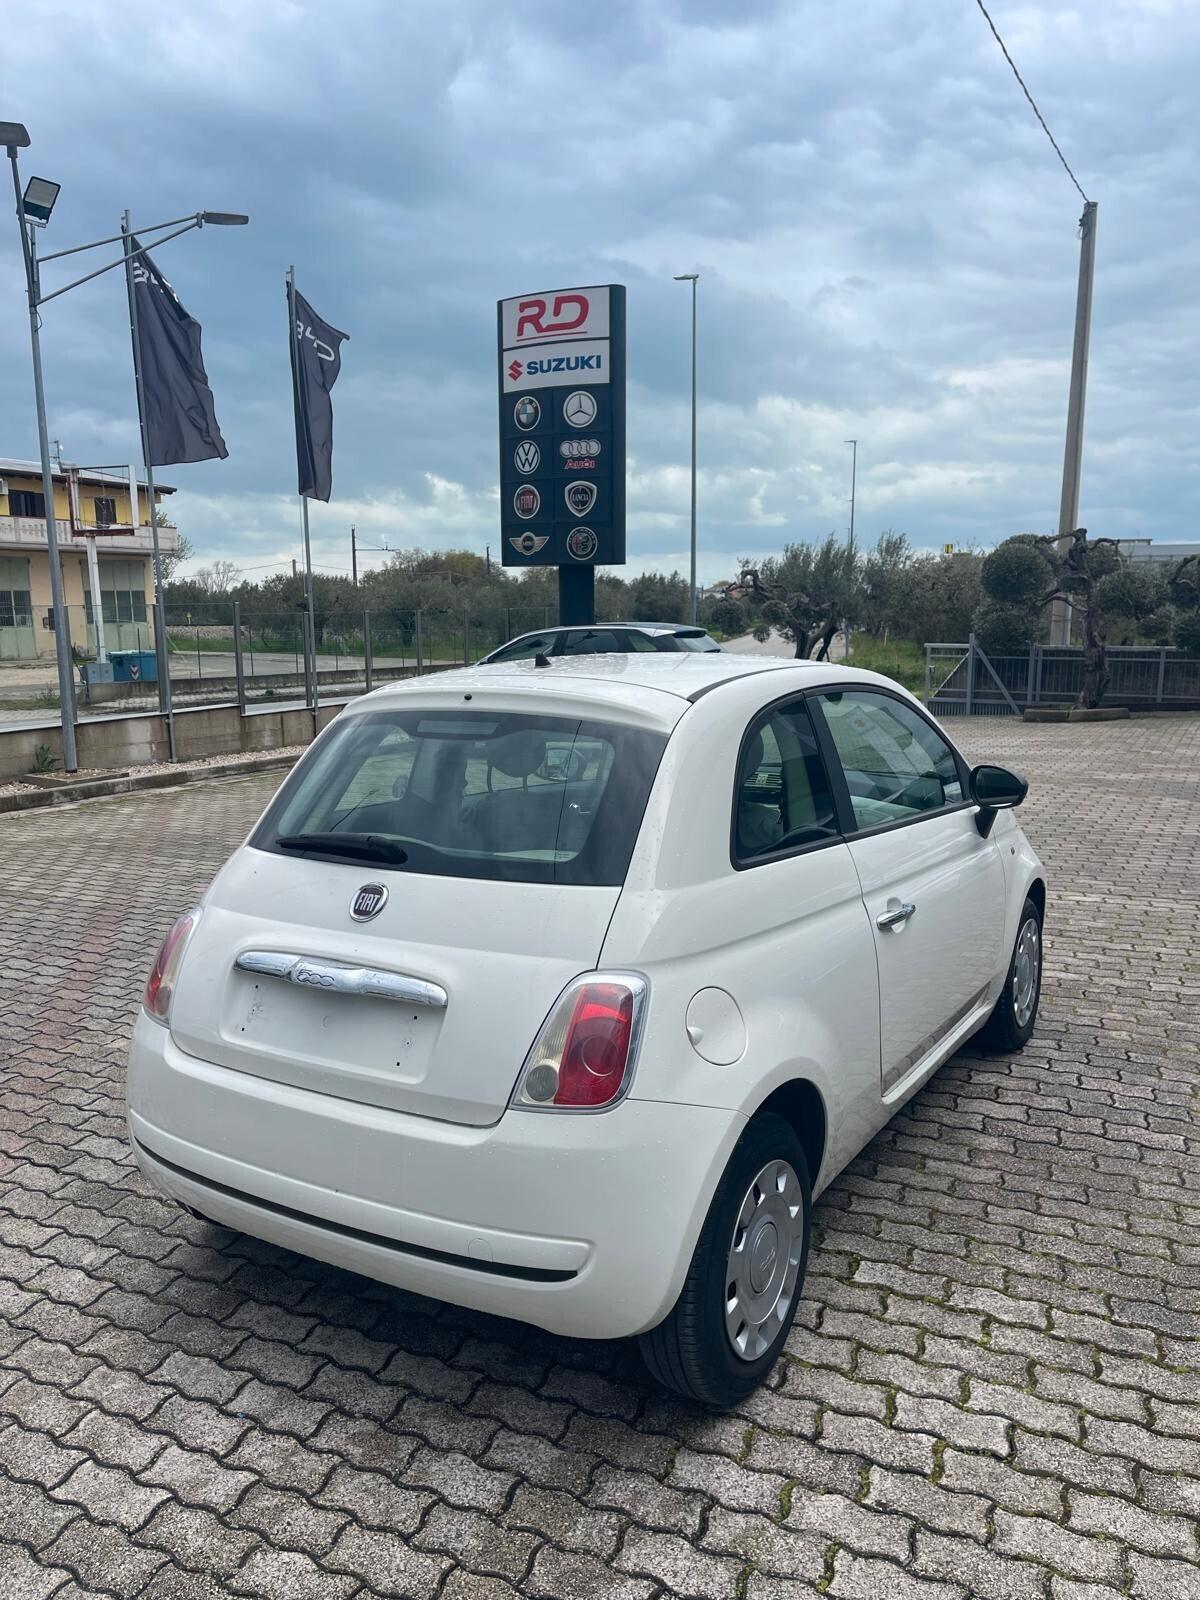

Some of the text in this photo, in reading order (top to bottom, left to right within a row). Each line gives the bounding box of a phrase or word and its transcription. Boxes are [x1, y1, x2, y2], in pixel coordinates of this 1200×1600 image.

[517, 295, 589, 337] RD
[526, 355, 602, 376] SUZUKI
[520, 495, 534, 510] FIAT
[355, 892, 381, 912] FIAT
[296, 968, 335, 987] 500
